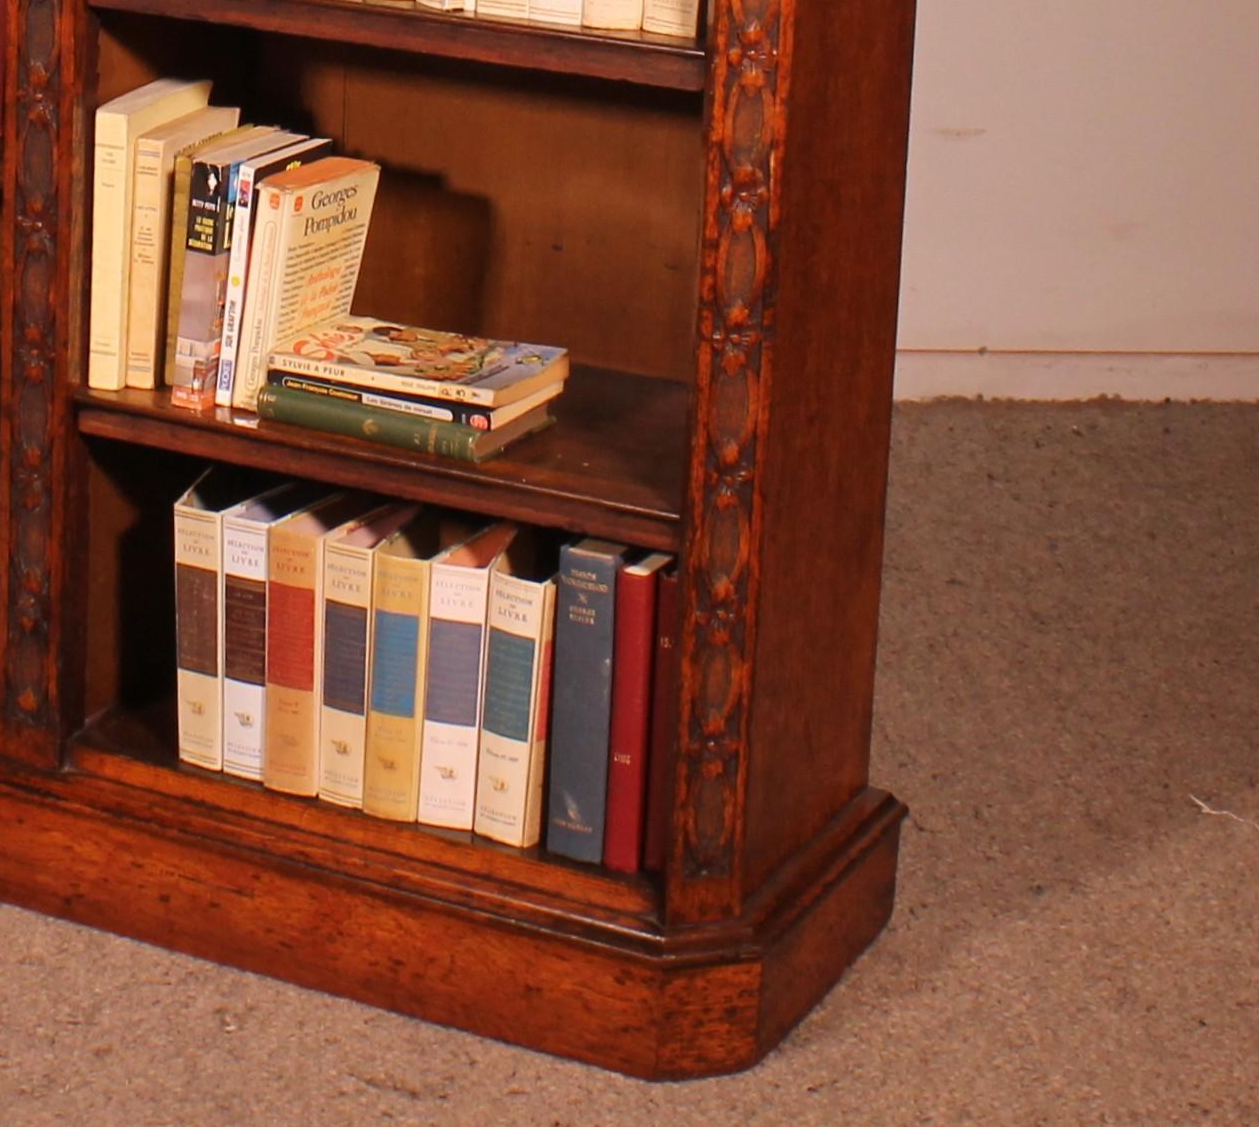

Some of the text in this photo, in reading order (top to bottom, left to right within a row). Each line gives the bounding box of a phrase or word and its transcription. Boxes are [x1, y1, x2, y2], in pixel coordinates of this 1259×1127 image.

[311, 184, 359, 211] Georges
[303, 205, 358, 237] Pompidou
[282, 358, 311, 371] SYLVIE
[323, 366, 345, 377] PEUR
[182, 544, 210, 557] LIVRE
[231, 555, 259, 568] LIVRE
[332, 579, 361, 594] LIVRE
[497, 605, 528, 623] LIVRE
